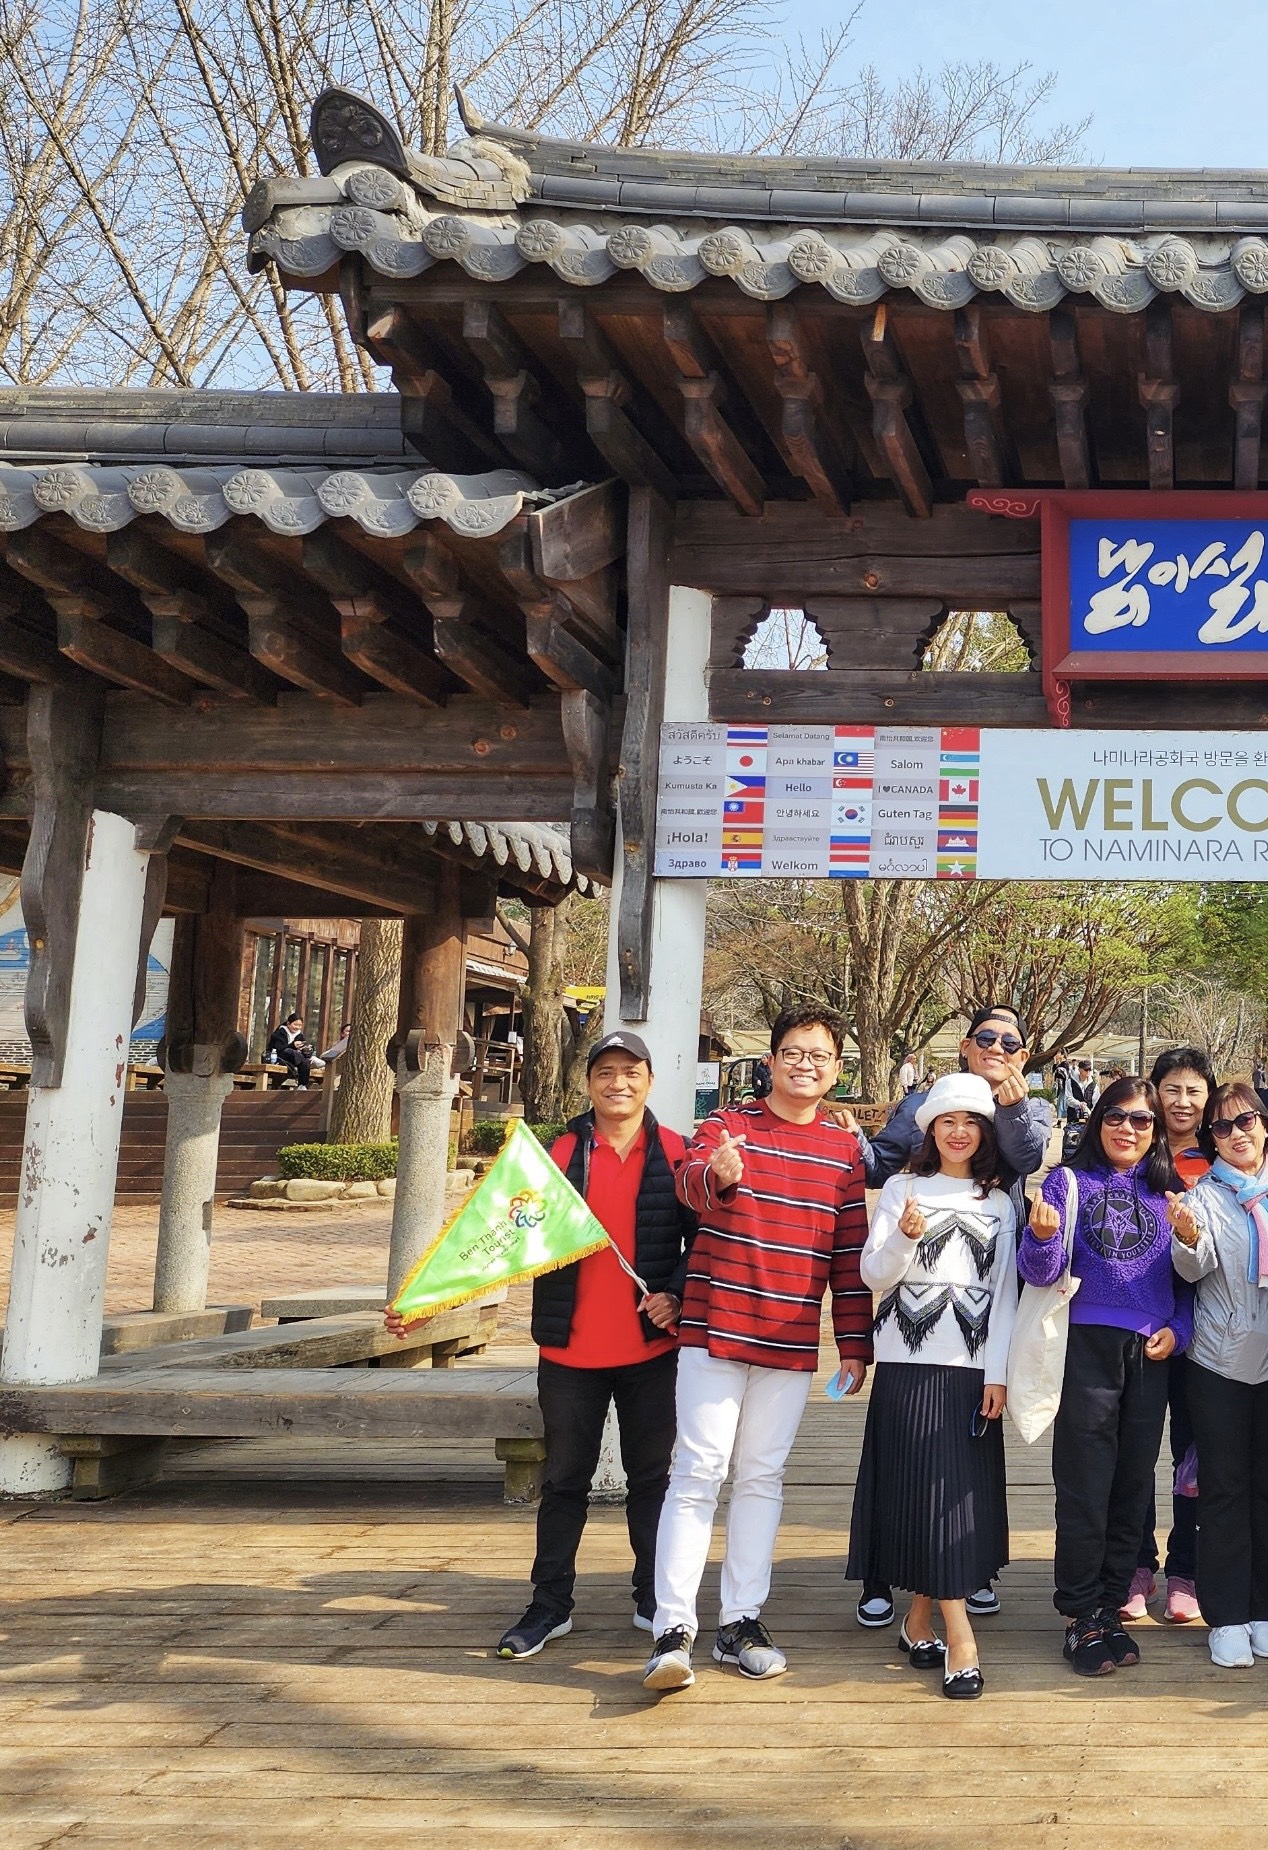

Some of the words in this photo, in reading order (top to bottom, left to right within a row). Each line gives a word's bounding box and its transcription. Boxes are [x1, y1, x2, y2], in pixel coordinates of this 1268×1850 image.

[773, 732, 803, 740] Selamat
[805, 732, 830, 741] Datang
[673, 755, 713, 766] ようこそ
[776, 757, 794, 767] Apa
[797, 757, 826, 766] khabar
[1094, 750, 1200, 766] 나미나라공화국
[1205, 751, 1250, 766] 방문을
[891, 759, 924, 769] Salom
[665, 781, 703, 790] Kumusta
[706, 782, 718, 790] Ka
[786, 782, 812, 792] Hello
[777, 808, 820, 819] 안녕하세요
[878, 808, 911, 819] Guten
[913, 809, 933, 821] Tag
[667, 832, 708, 844] ¡Hola!
[1039, 839, 1074, 861] TO
[1085, 839, 1244, 861] NAMINARA
[669, 858, 707, 870] Здраво
[772, 860, 818, 871] Welkom
[459, 1244, 480, 1261] Ben
[479, 1220, 508, 1245] Thanh
[482, 1229, 515, 1256] Tourist
